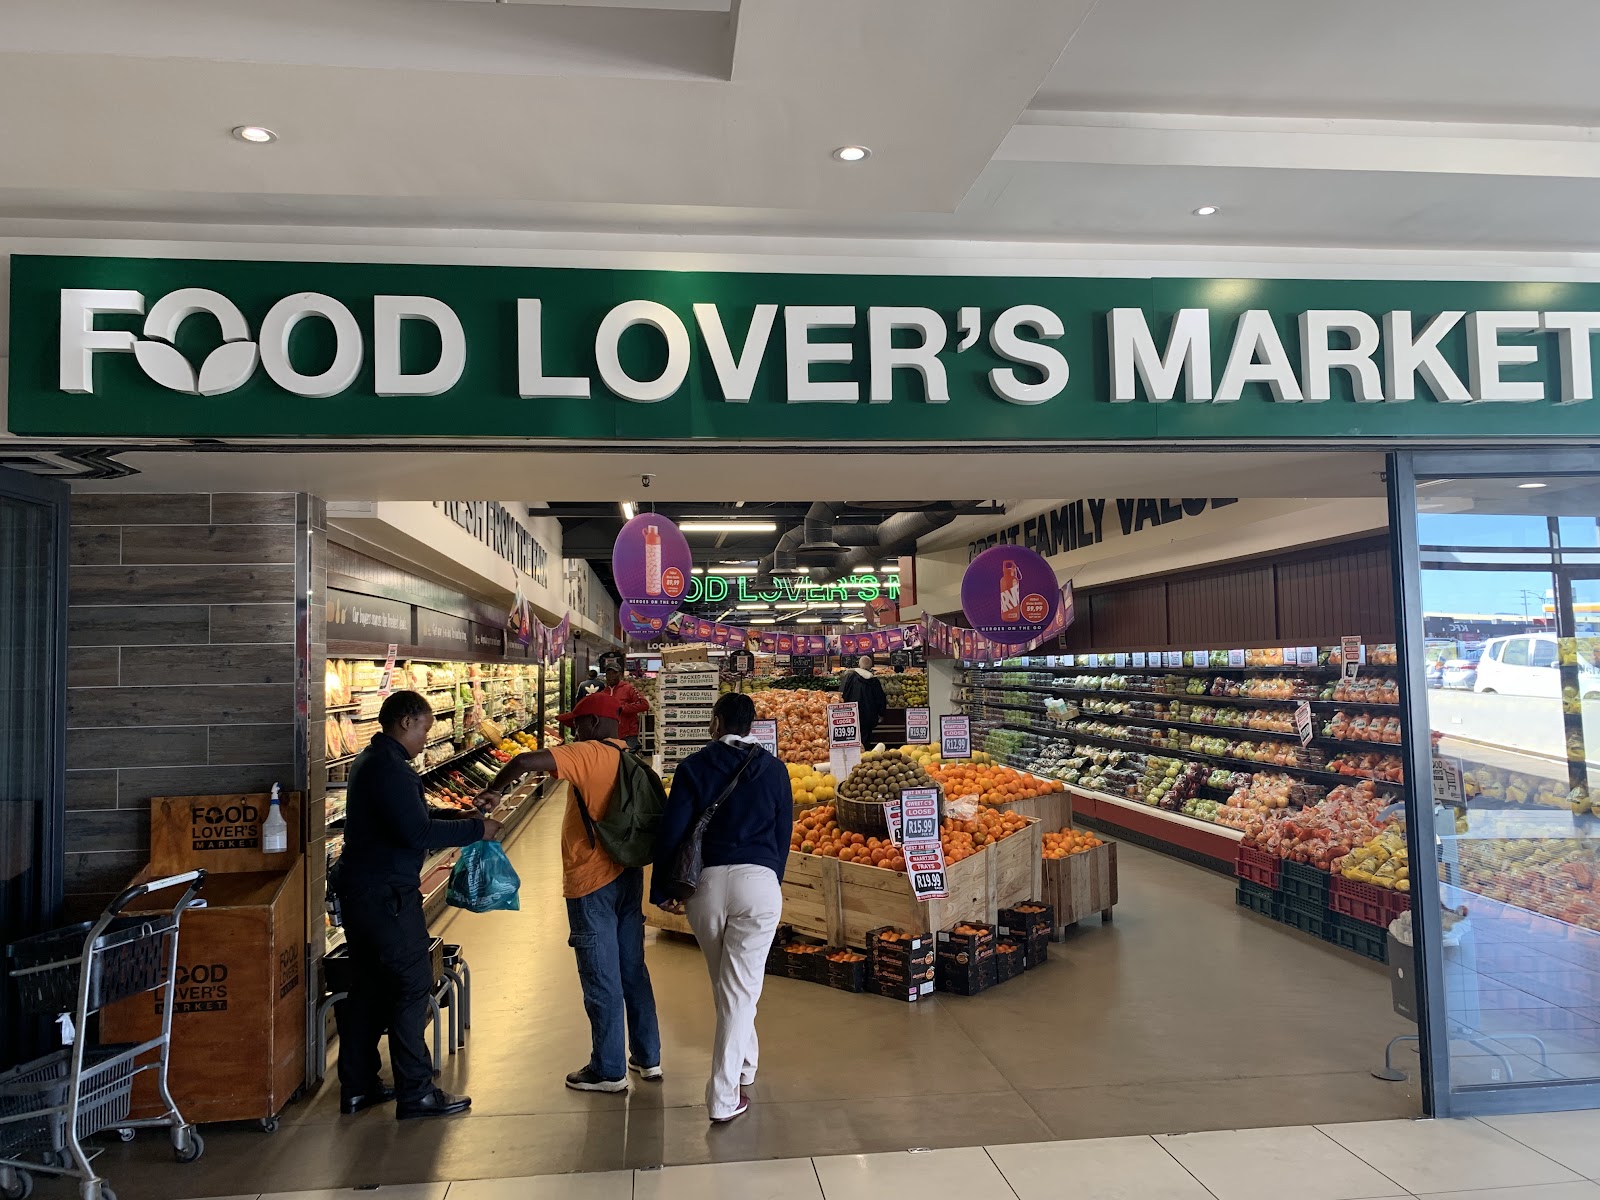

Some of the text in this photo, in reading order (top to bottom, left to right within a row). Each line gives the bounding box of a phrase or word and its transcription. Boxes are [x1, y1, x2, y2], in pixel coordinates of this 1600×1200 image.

[59, 286, 1600, 406] FOOD LOVER'S MARKET
[486, 500, 514, 566] FROM
[1023, 498, 1106, 558] FAMILY
[684, 576, 729, 602] OD
[647, 642, 674, 650] LOCAL
[834, 727, 855, 738] R39.99
[946, 739, 966, 750] R12.99
[192, 805, 258, 825] FOOD
[908, 808, 932, 816] LOOSE
[192, 825, 258, 839] LOVER'S
[908, 820, 933, 834] R15.99
[195, 839, 256, 849] MARKET
[916, 873, 941, 889] R19.99
